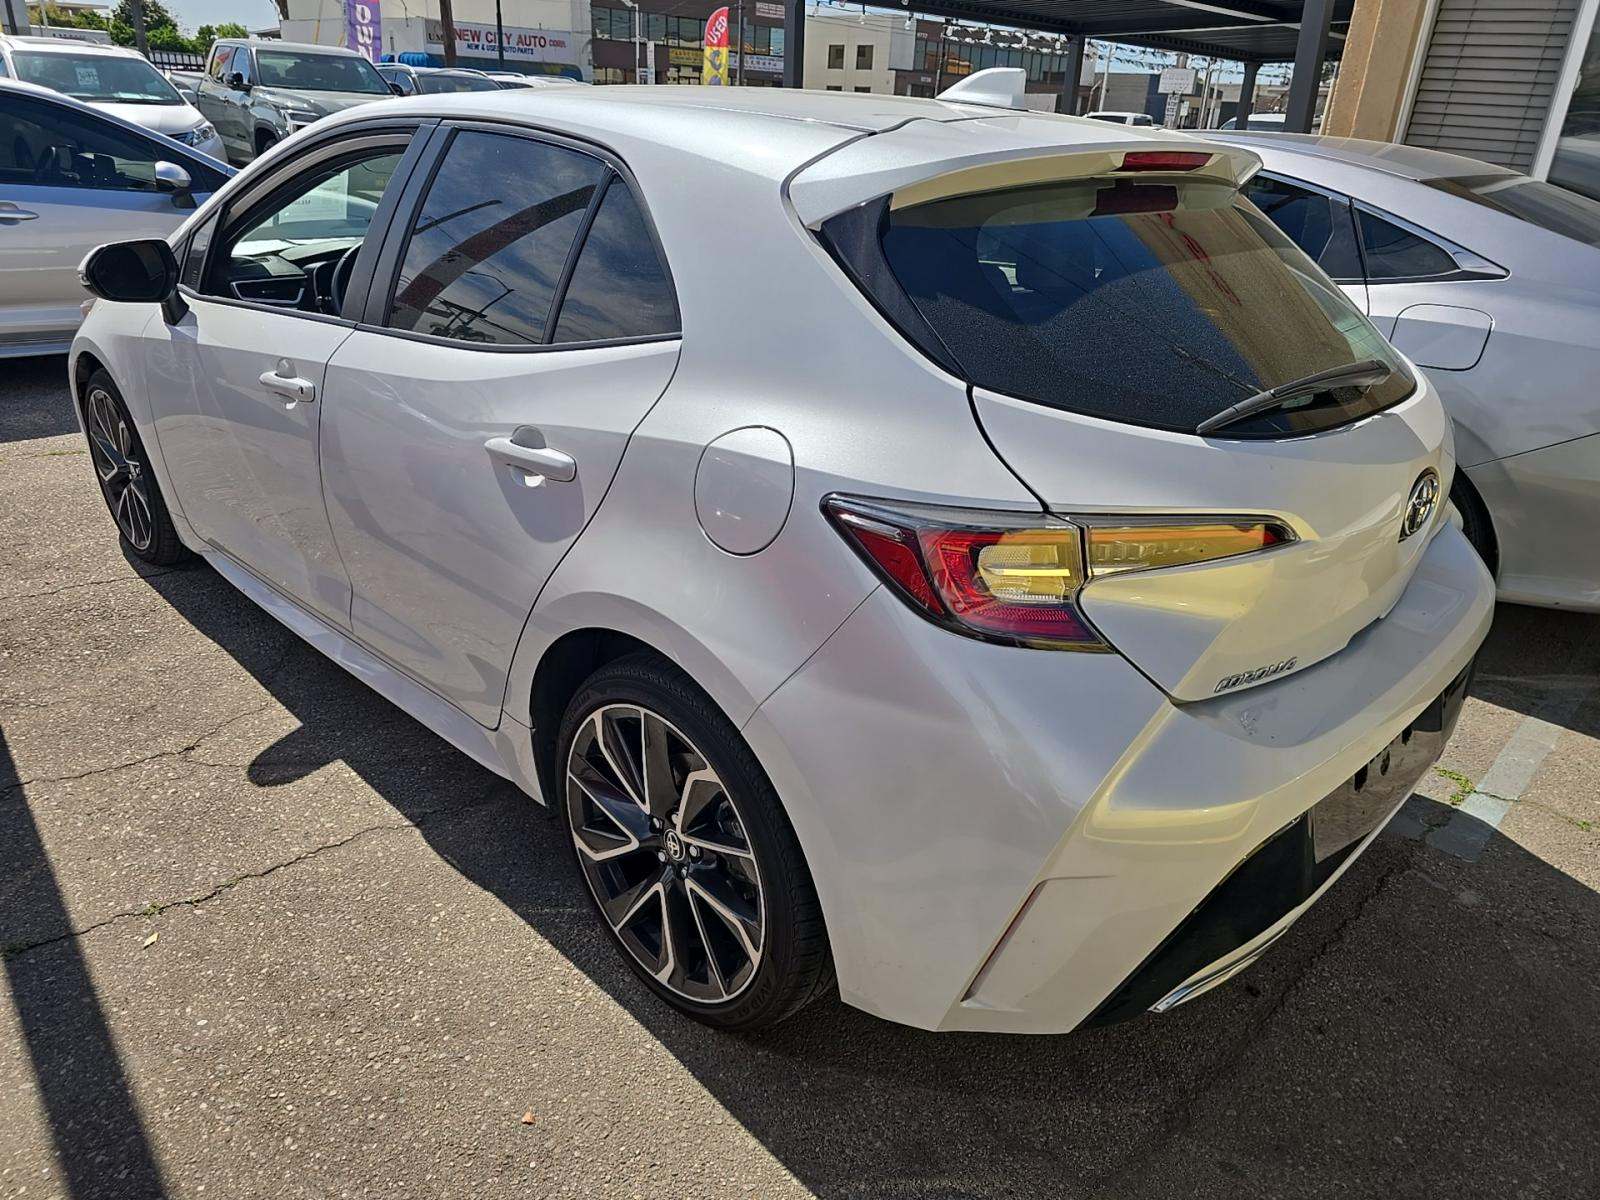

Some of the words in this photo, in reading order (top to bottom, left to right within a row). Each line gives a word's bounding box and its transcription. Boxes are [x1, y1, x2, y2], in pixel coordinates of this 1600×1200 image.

[455, 28, 481, 42] NEW
[485, 31, 513, 46] CIY
[516, 34, 547, 48] AUTO
[707, 16, 728, 44] USED
[467, 43, 480, 51] NEW
[517, 47, 534, 55] PARTS
[1214, 656, 1297, 693] COROLLA
